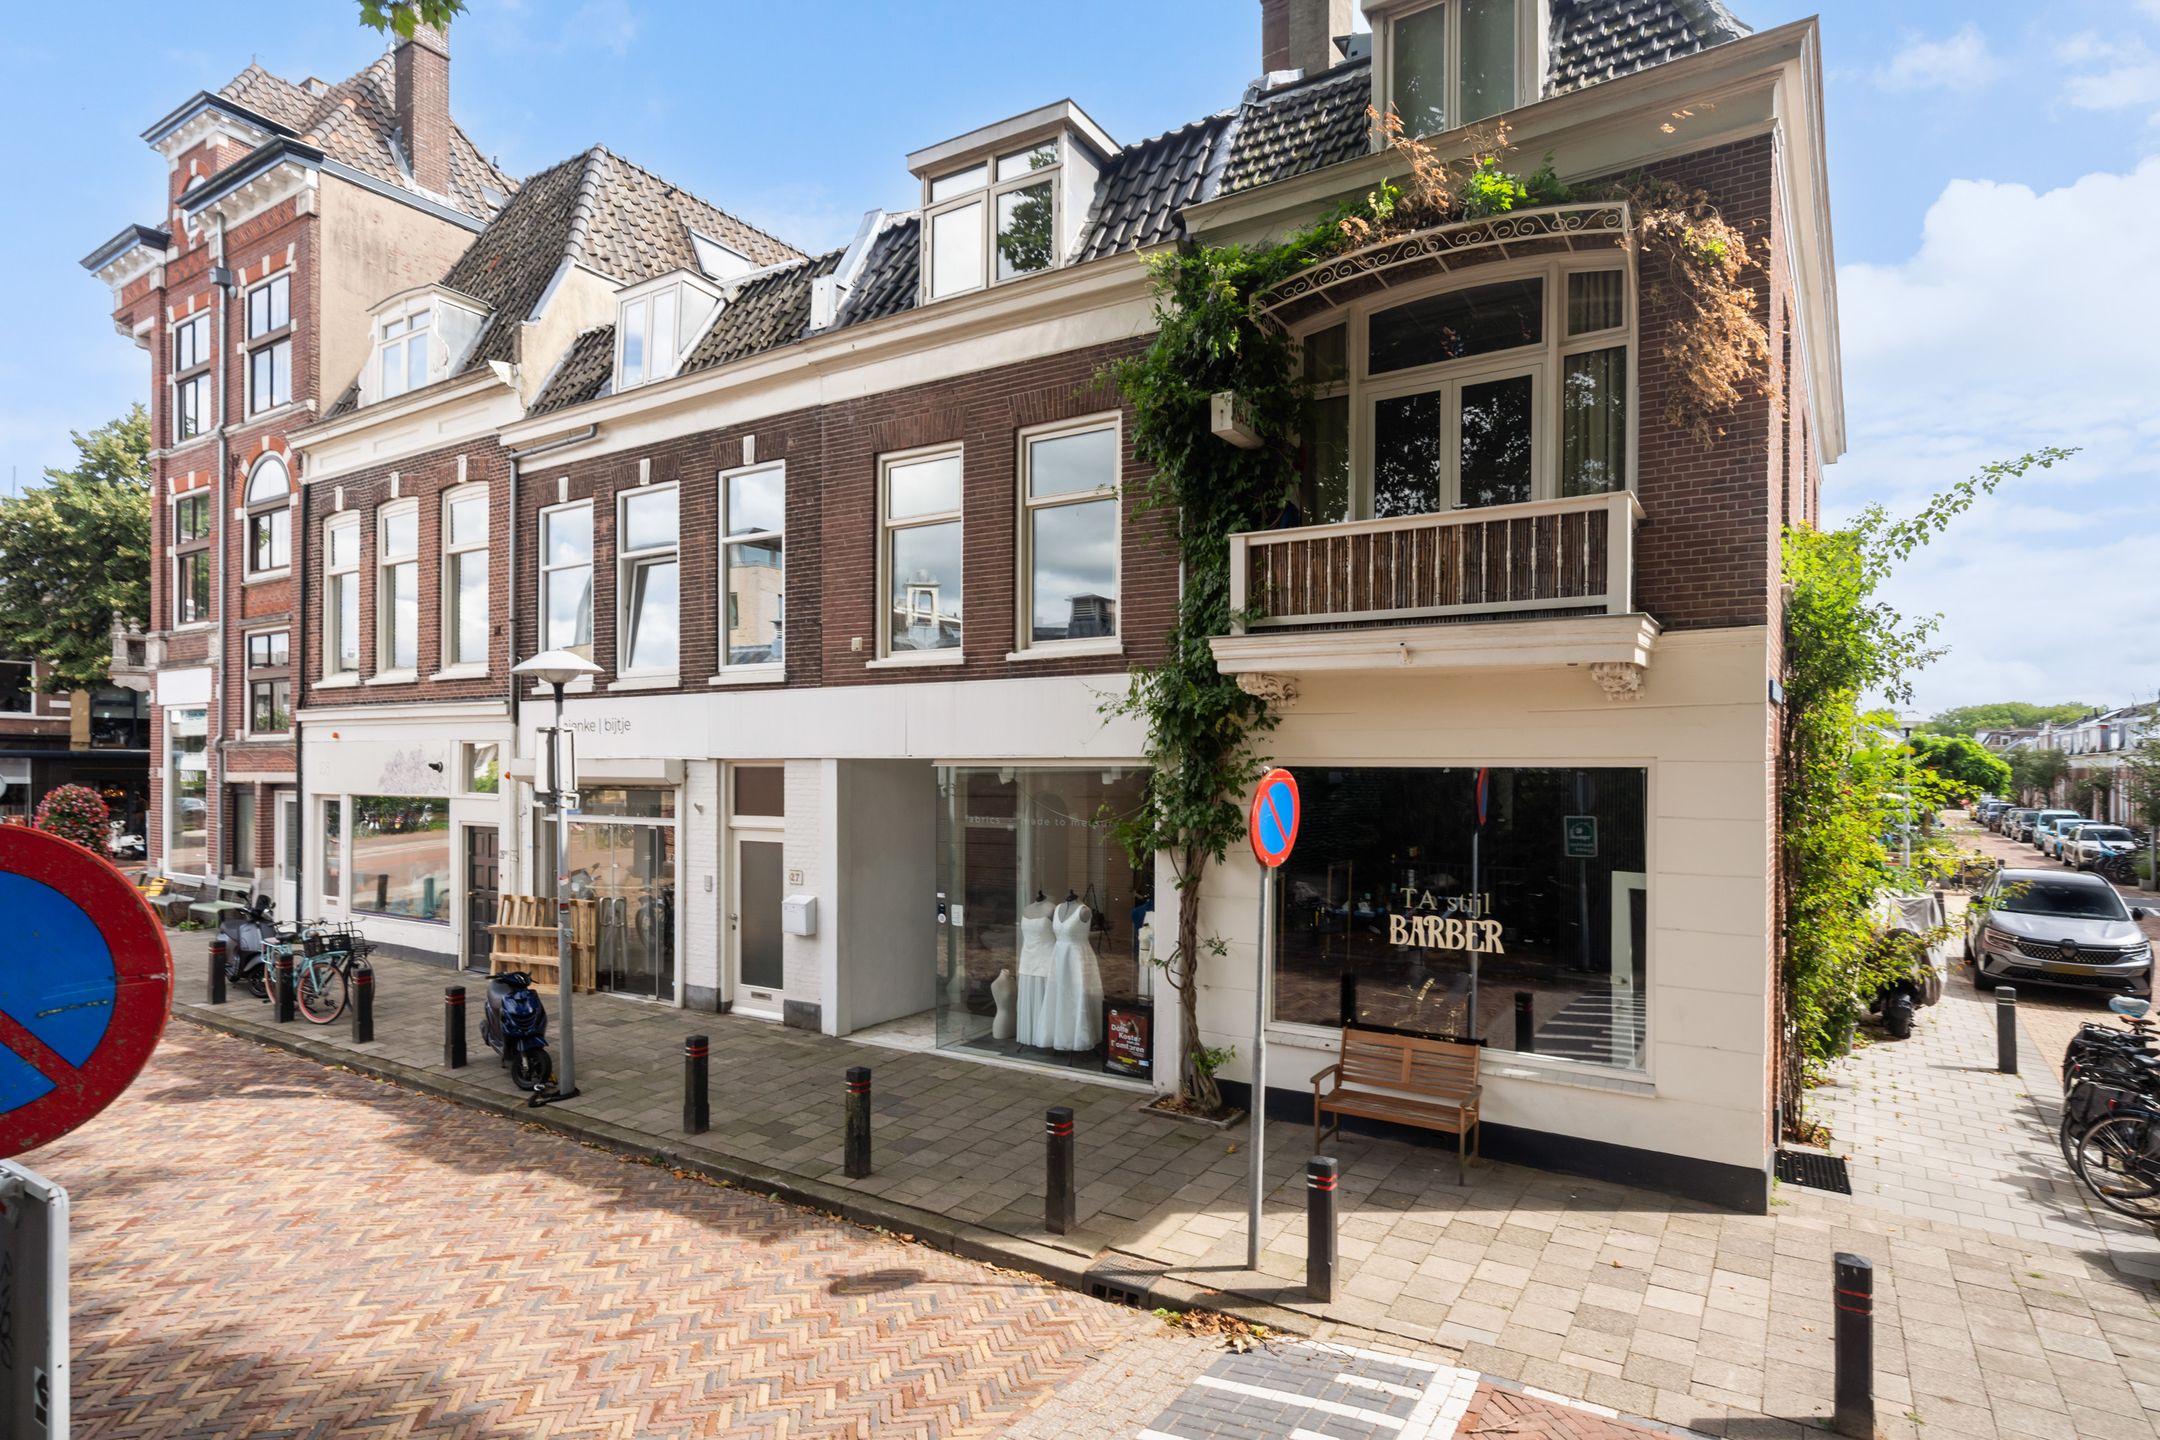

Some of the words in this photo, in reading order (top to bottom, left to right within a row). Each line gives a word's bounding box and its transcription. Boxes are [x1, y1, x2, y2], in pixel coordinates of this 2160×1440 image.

[563, 718, 596, 732] ienke
[604, 717, 631, 734] bijtje
[1055, 818, 1066, 827] to
[1447, 892, 1491, 919] stijl
[1389, 914, 1505, 954] BARBER
